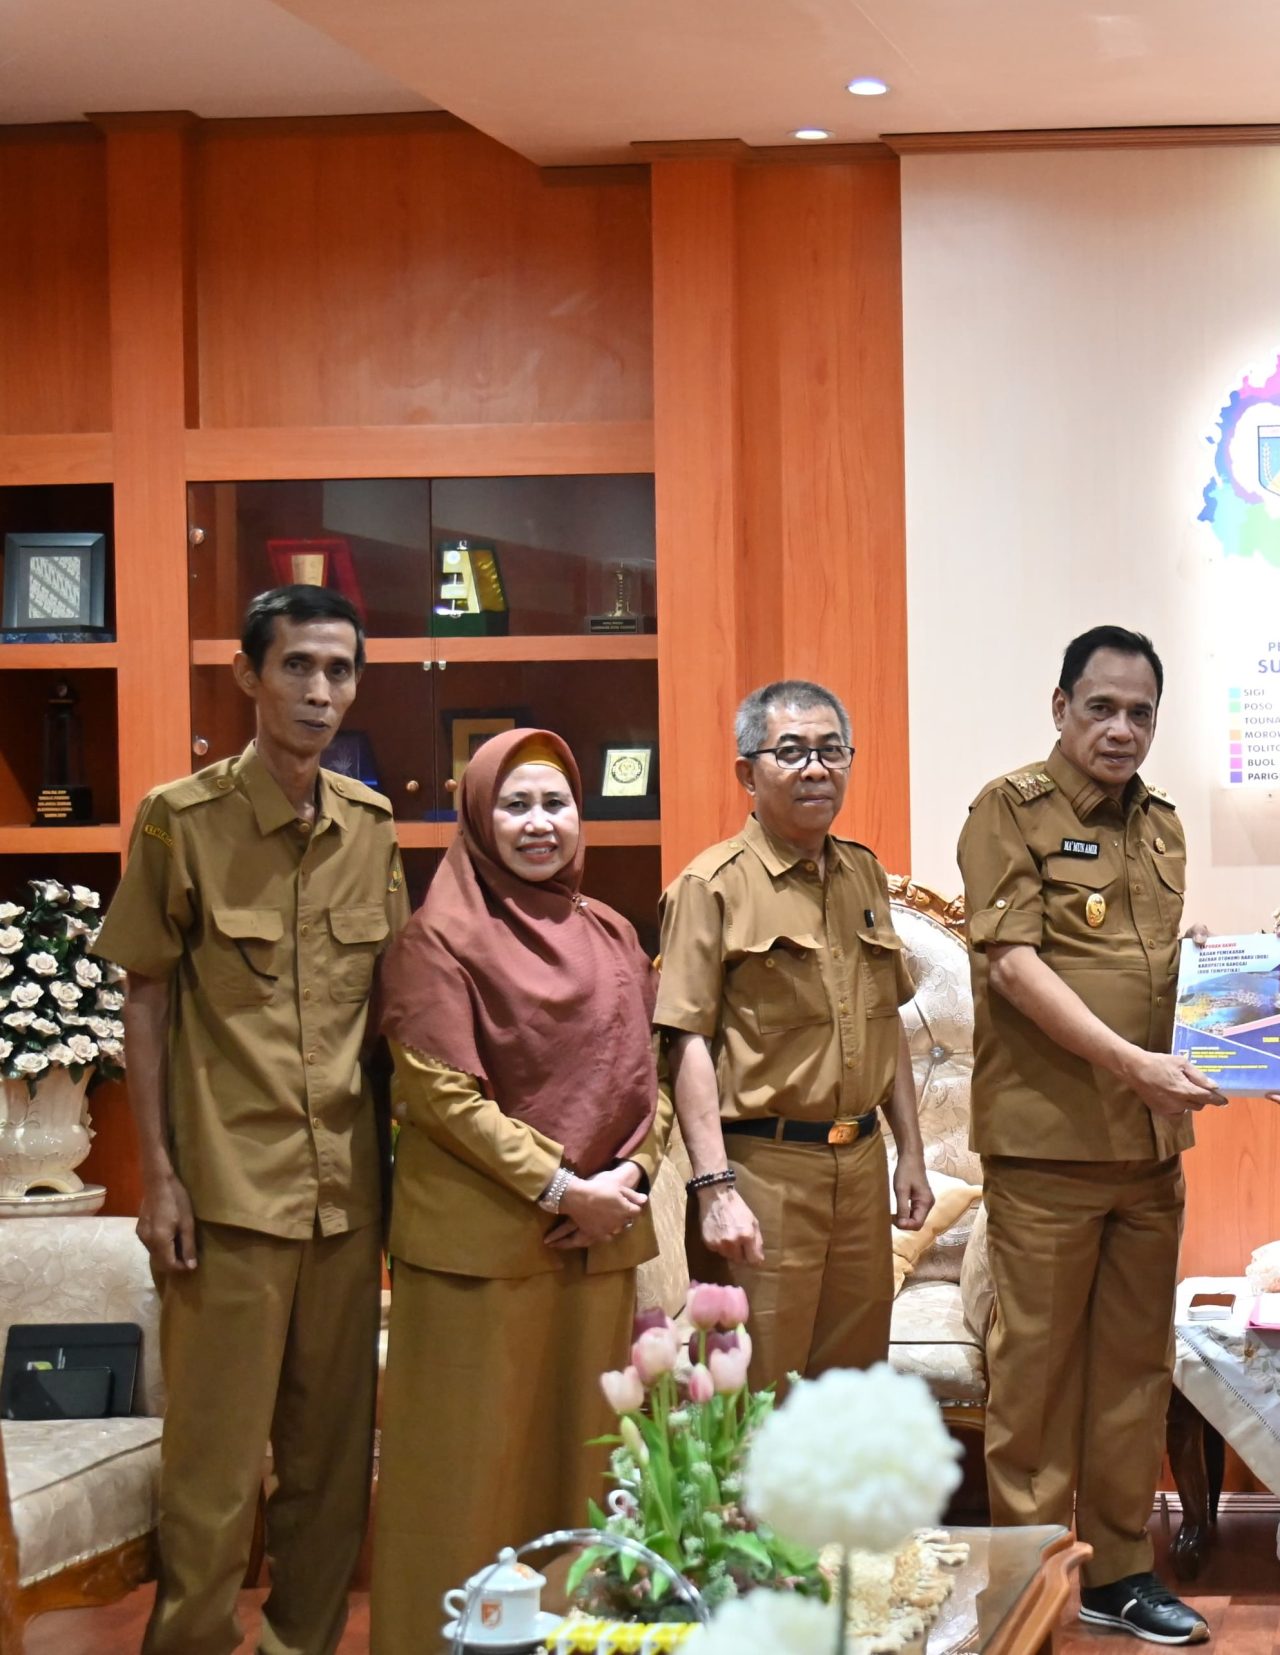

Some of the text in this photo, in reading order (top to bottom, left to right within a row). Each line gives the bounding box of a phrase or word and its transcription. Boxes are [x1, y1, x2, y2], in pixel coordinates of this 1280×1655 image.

[1243, 688, 1265, 697] SIGI
[1244, 702, 1273, 711] POSO
[1245, 716, 1280, 725] TOUNA
[1247, 758, 1276, 767] BUOL
